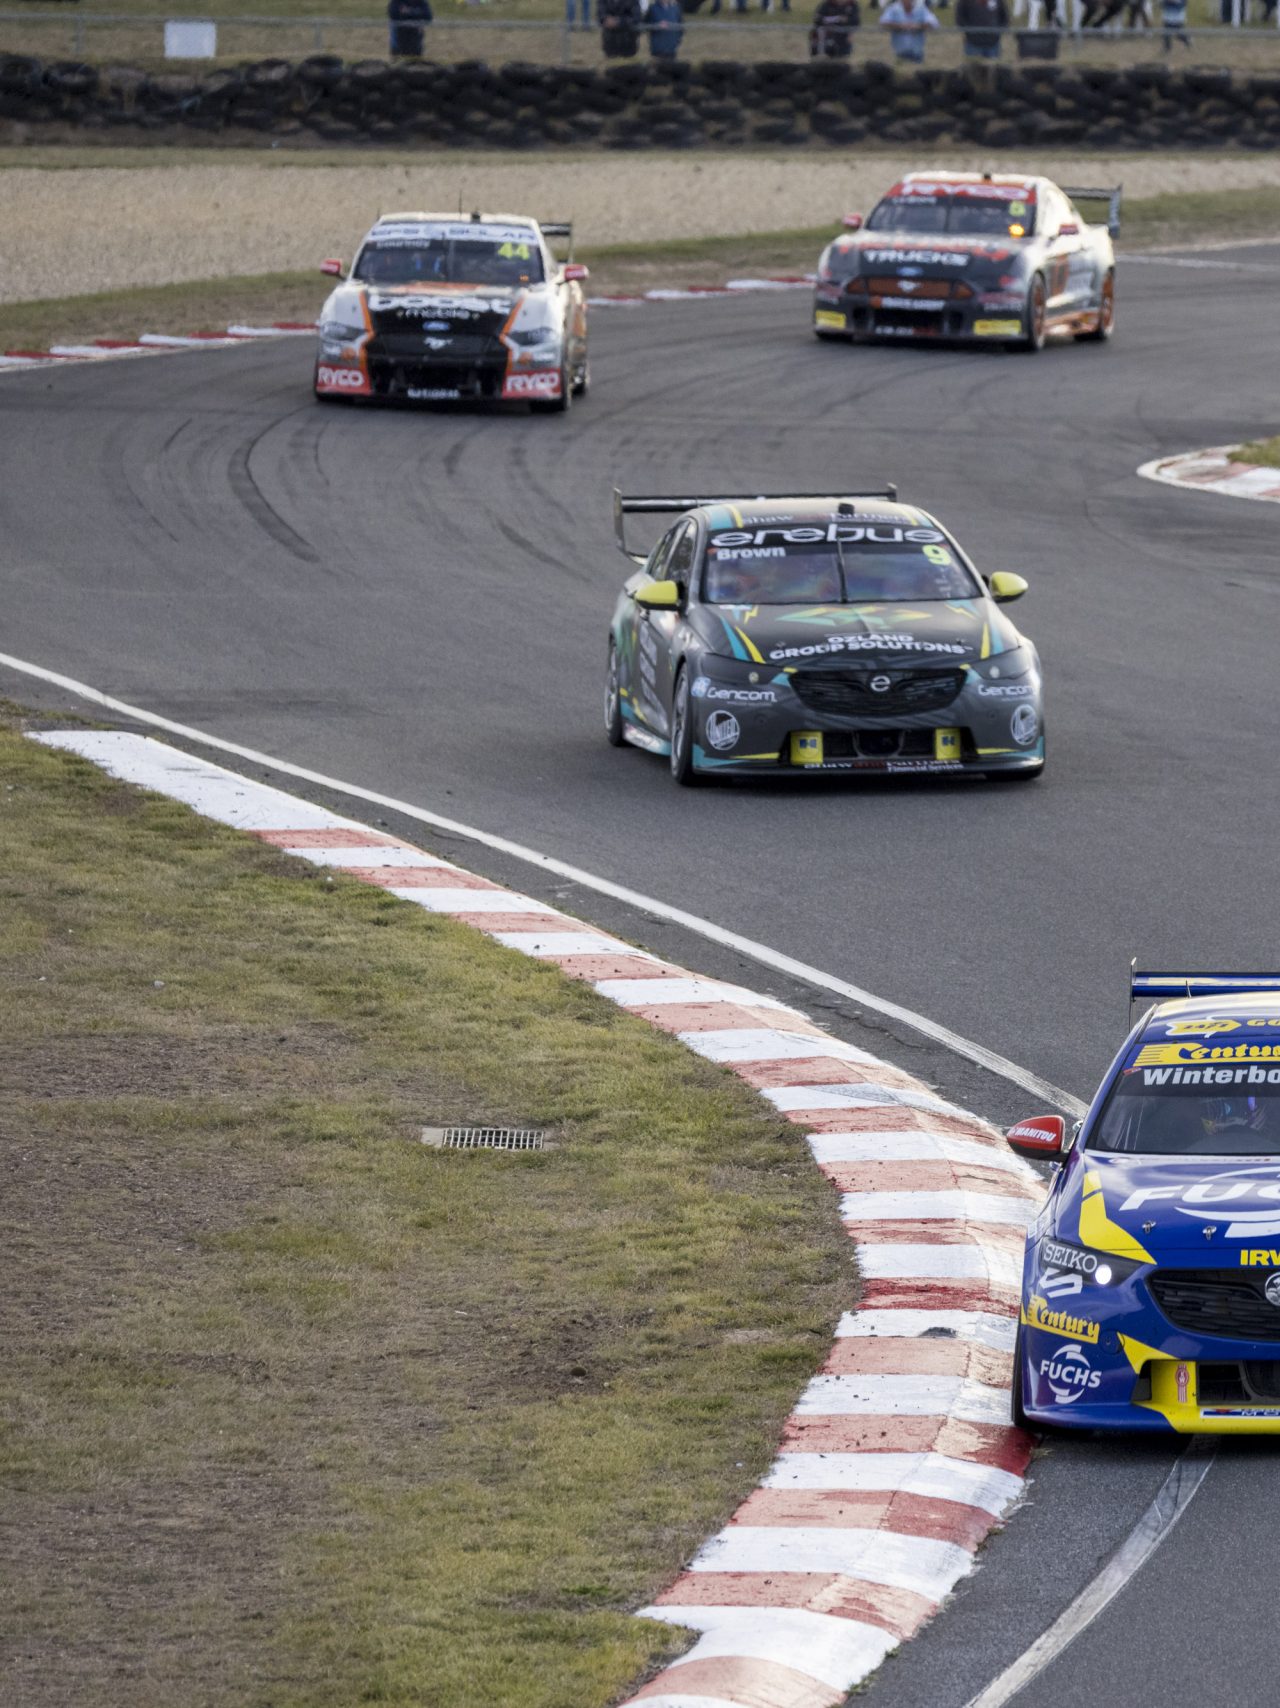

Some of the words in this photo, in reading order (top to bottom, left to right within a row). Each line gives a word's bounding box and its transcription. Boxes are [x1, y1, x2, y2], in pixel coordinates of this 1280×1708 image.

[498, 242, 530, 261] 44
[863, 249, 970, 267] TRUCKS
[318, 366, 365, 387] RYCO
[506, 371, 560, 392] RYCO
[711, 523, 945, 548] erebus
[716, 546, 786, 561] Brown
[922, 544, 951, 566] 9
[827, 634, 914, 642] OZLAND
[769, 641, 845, 660] GROUP
[848, 639, 967, 655] SOLUTIONS
[707, 687, 778, 702] Gencom
[1014, 1127, 1057, 1142] MANITOU
[1043, 1243, 1098, 1273] SEIKO
[1029, 1294, 1100, 1344] Century
[1040, 1359, 1102, 1389] FUCHS
